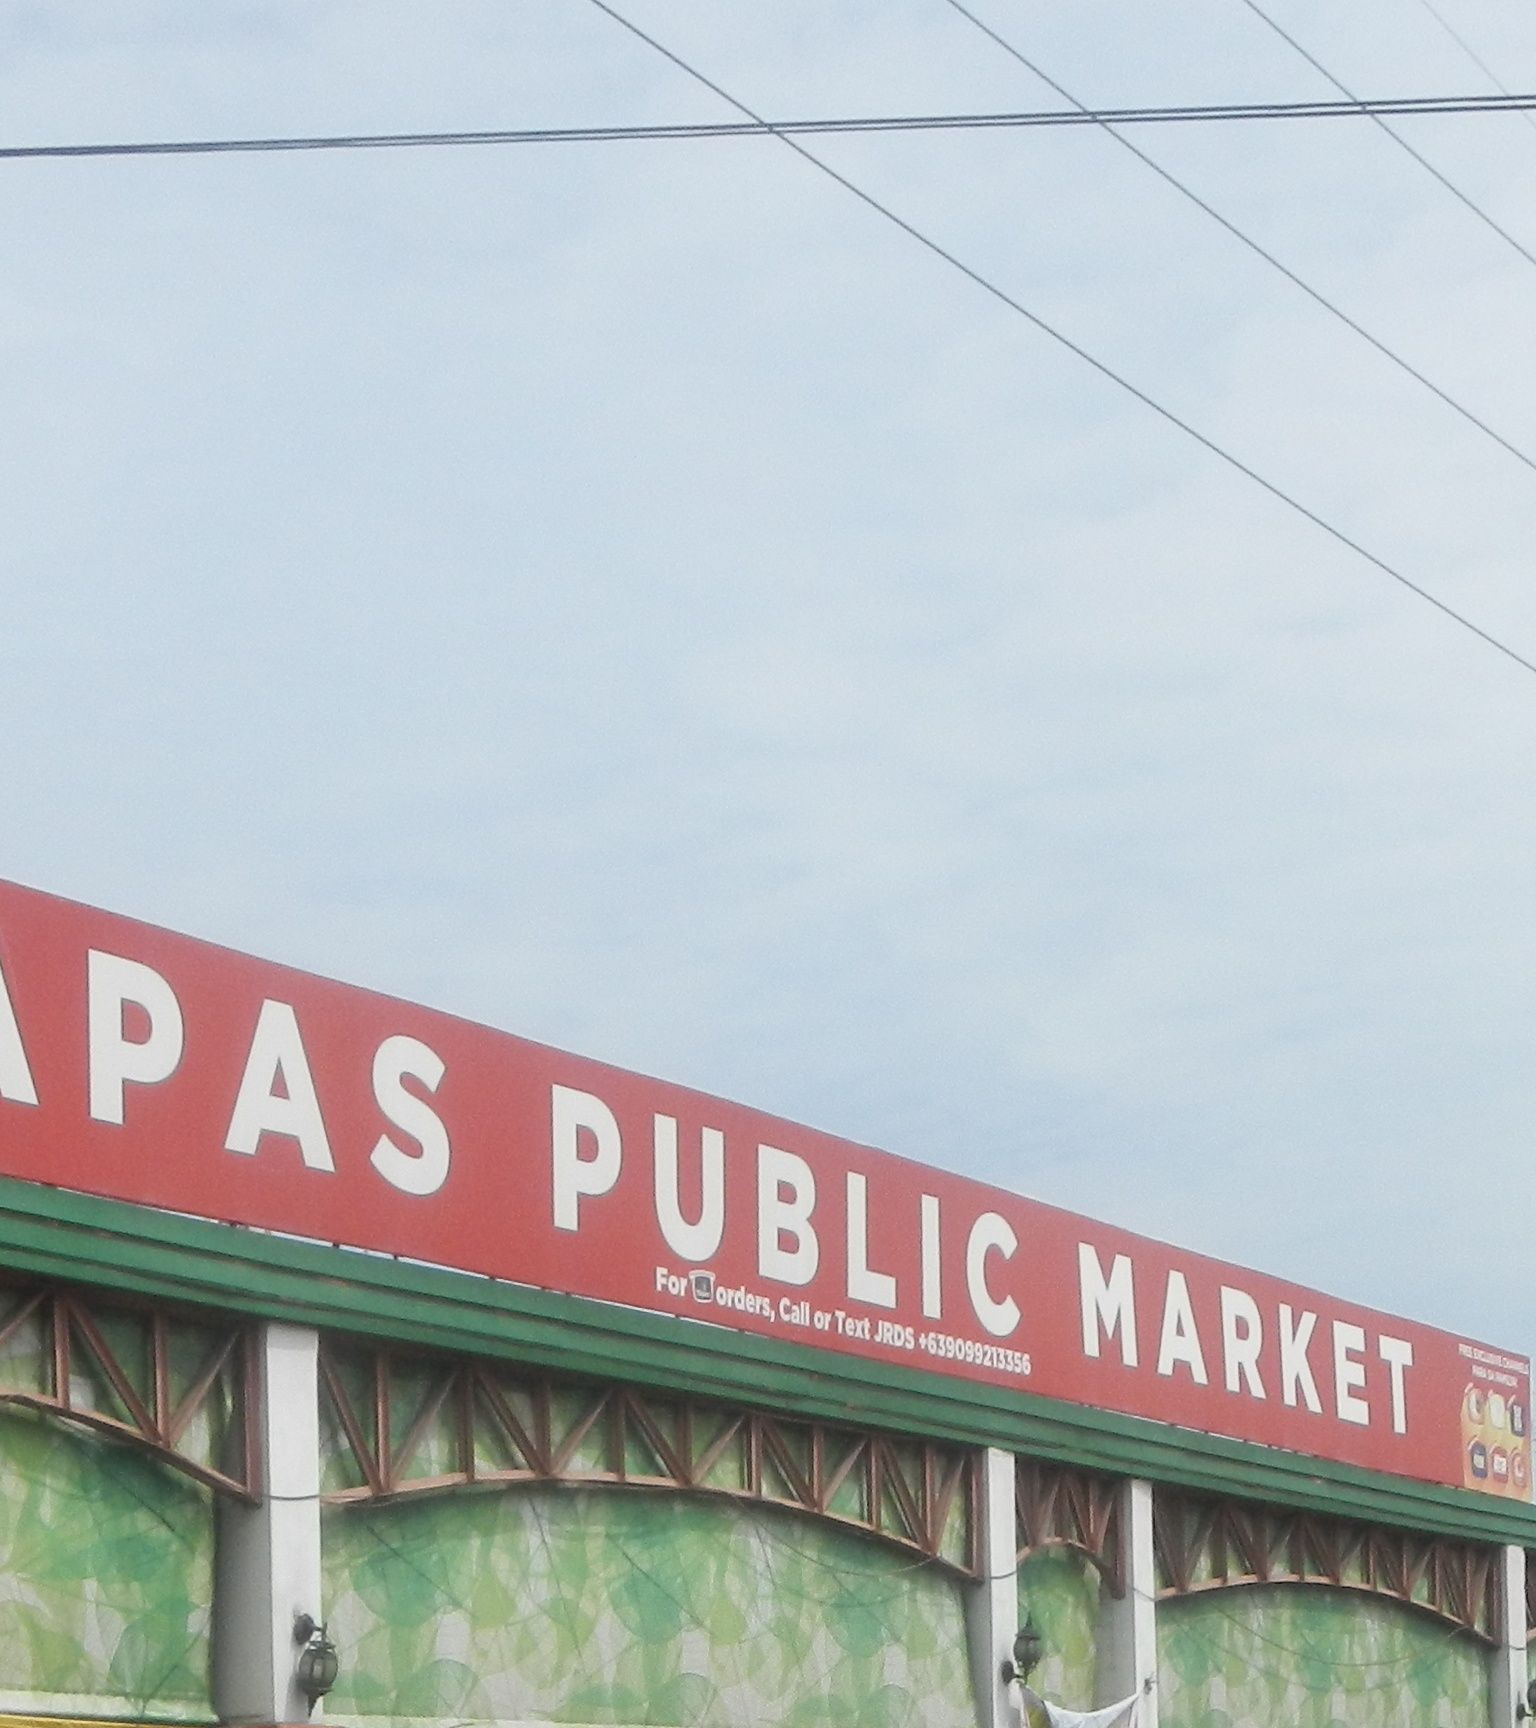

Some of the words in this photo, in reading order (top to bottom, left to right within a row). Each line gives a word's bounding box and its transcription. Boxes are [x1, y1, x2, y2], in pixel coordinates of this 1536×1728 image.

[552, 1083, 1024, 1338] PUBLIC
[1076, 1242, 1414, 1434] MARKET
[655, 1266, 688, 1297] For
[716, 1286, 775, 1323] orders,
[779, 1297, 810, 1326] Call
[814, 1312, 832, 1331] or
[834, 1310, 871, 1340] Text
[874, 1319, 915, 1350] JRDS
